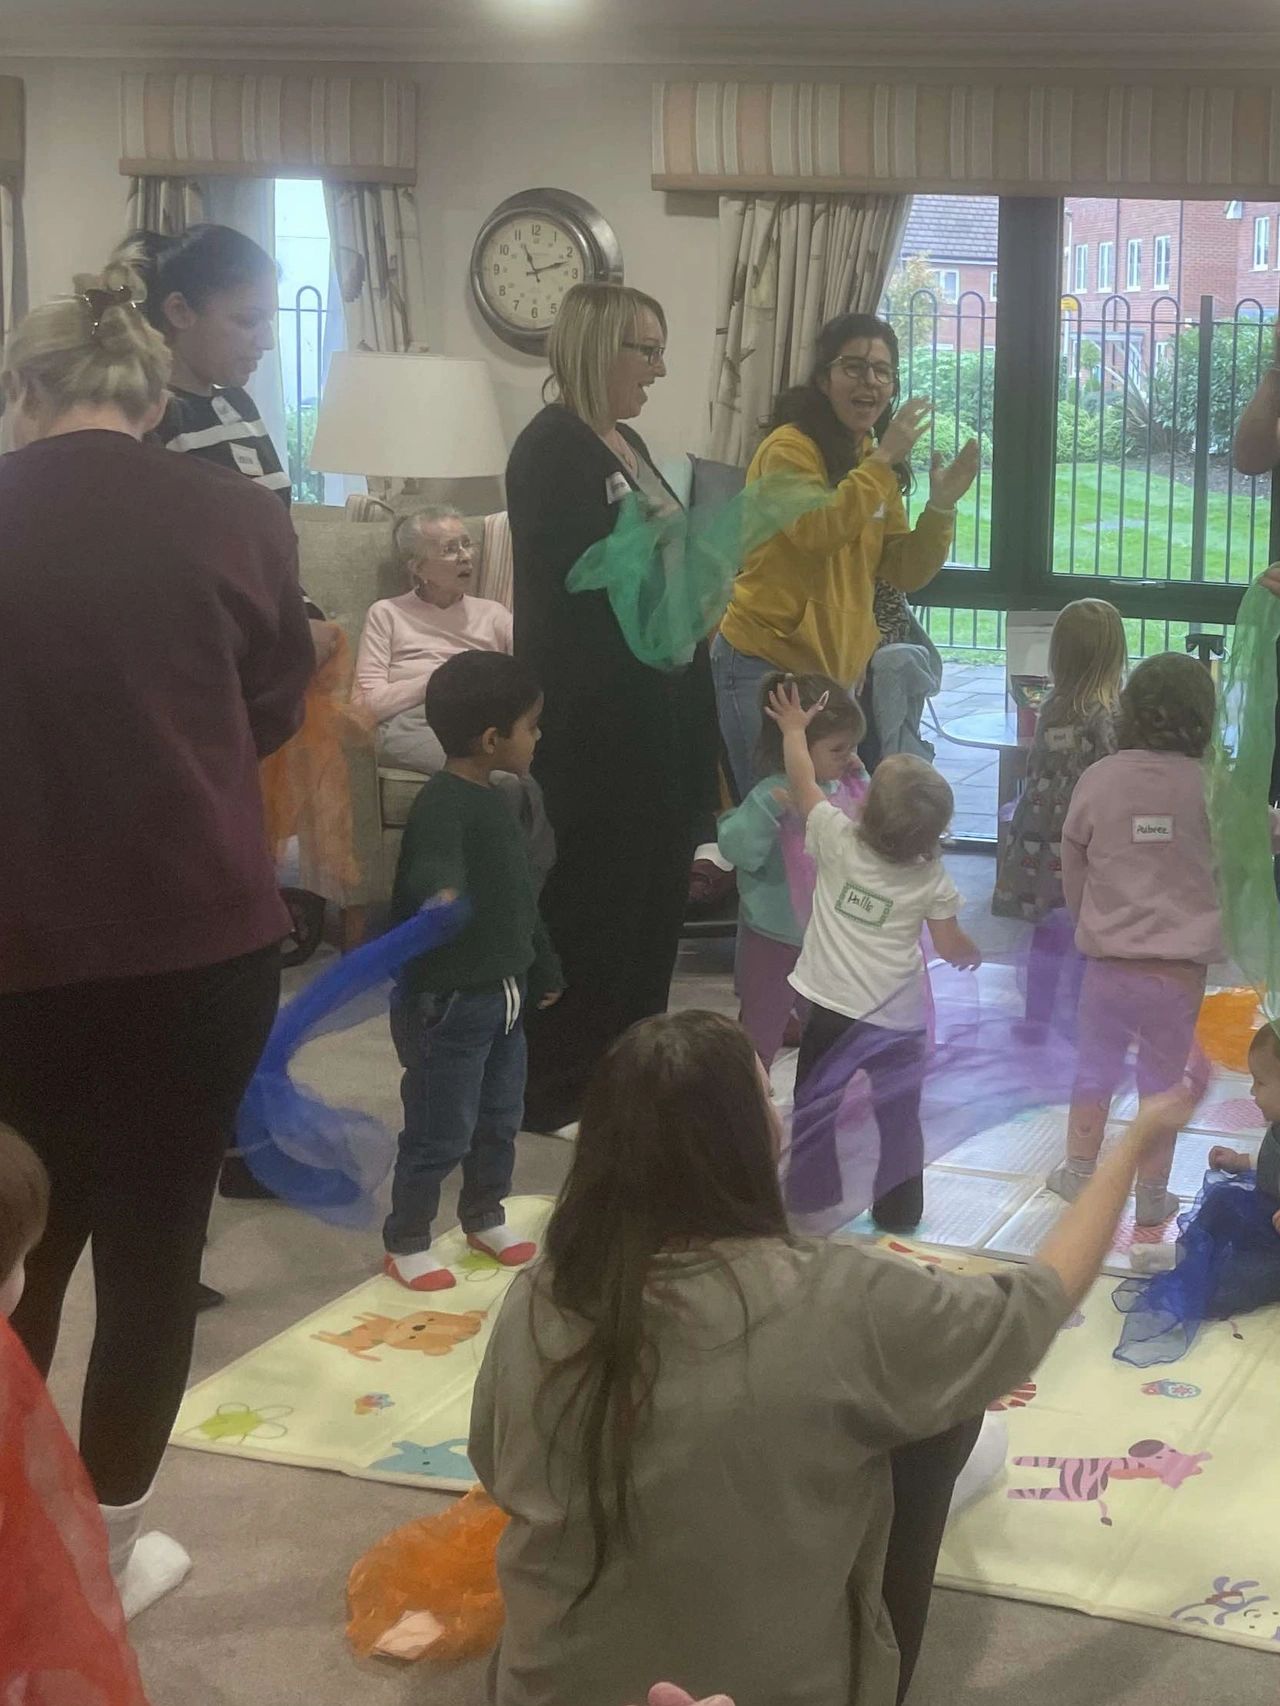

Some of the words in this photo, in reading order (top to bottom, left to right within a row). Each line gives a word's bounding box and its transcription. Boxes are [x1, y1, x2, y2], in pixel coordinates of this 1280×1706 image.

[514, 229, 522, 241] 11
[531, 224, 542, 236] 12
[553, 231, 558, 242] 1
[499, 244, 510, 256] 10
[566, 246, 574, 258] 2
[493, 263, 501, 275] 9
[571, 267, 579, 279] 3
[498, 285, 507, 297] 8
[512, 299, 520, 311] 7
[550, 302, 558, 314] 5
[531, 306, 539, 319] 6
